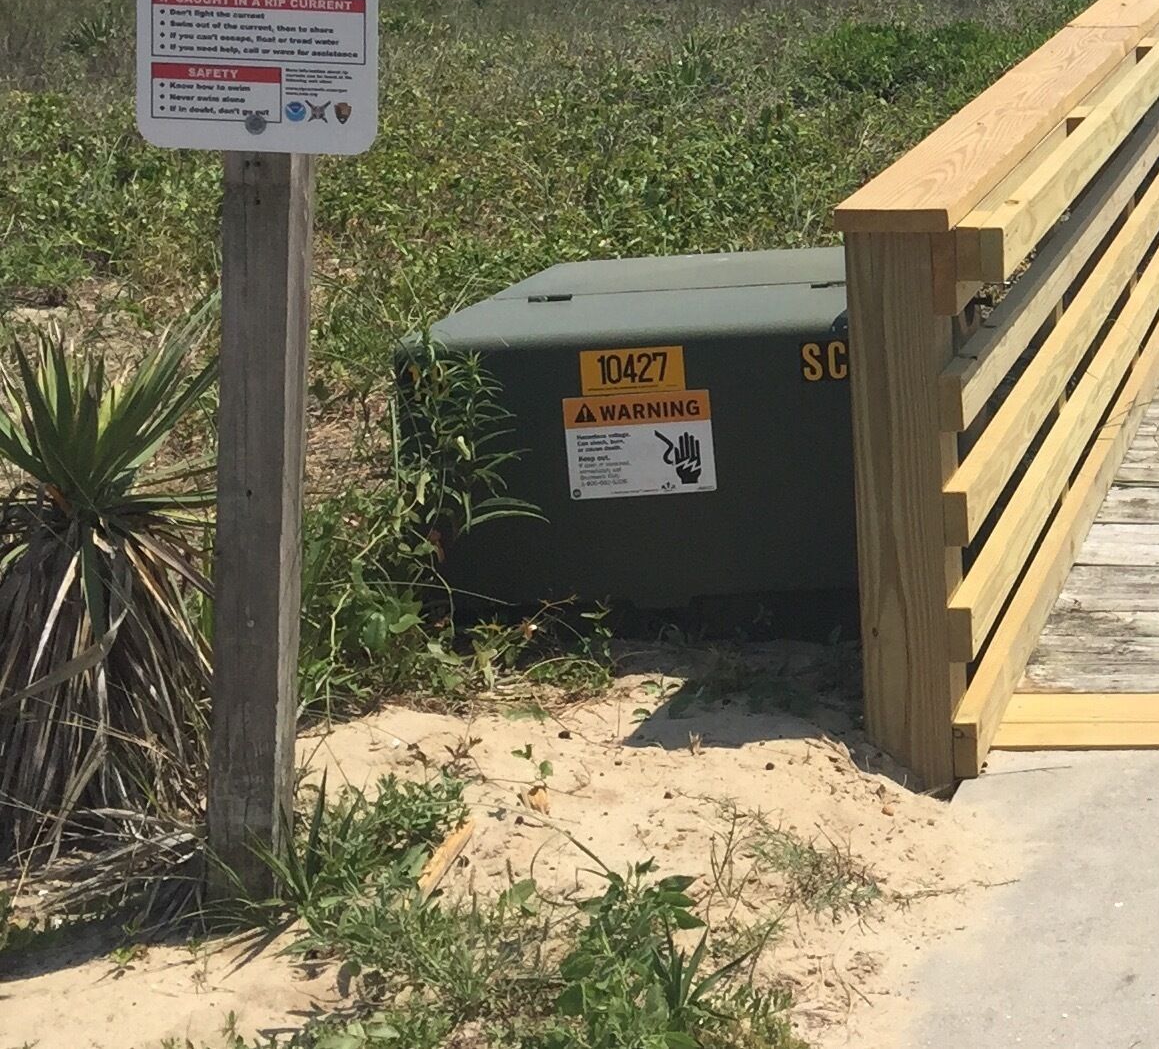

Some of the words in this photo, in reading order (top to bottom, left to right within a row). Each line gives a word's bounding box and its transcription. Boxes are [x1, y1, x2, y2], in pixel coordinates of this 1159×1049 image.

[188, 67, 238, 79] SAFETY
[597, 352, 667, 385] 10427
[600, 399, 700, 422] WARNING
